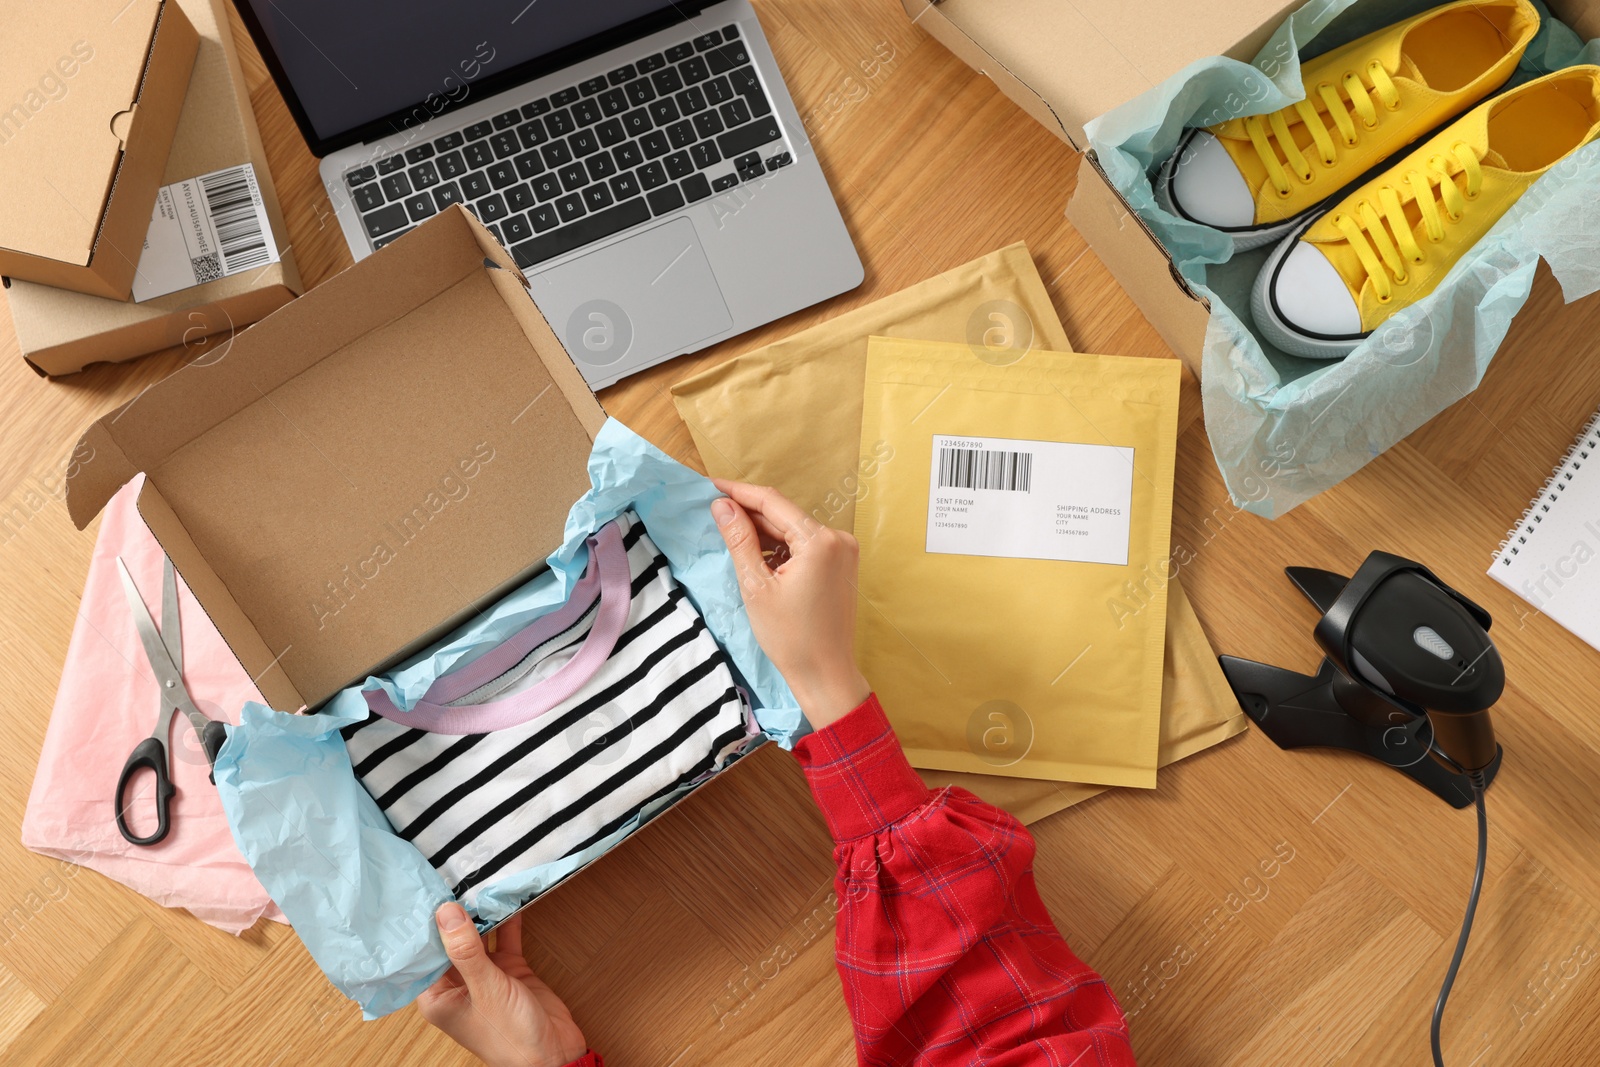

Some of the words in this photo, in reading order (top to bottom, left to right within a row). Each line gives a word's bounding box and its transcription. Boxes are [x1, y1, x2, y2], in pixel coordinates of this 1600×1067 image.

[244, 166, 261, 206] 1234567890
[166, 204, 174, 219] FROM
[940, 440, 983, 448] 1234567890
[1057, 505, 1088, 513] SHIPPING
